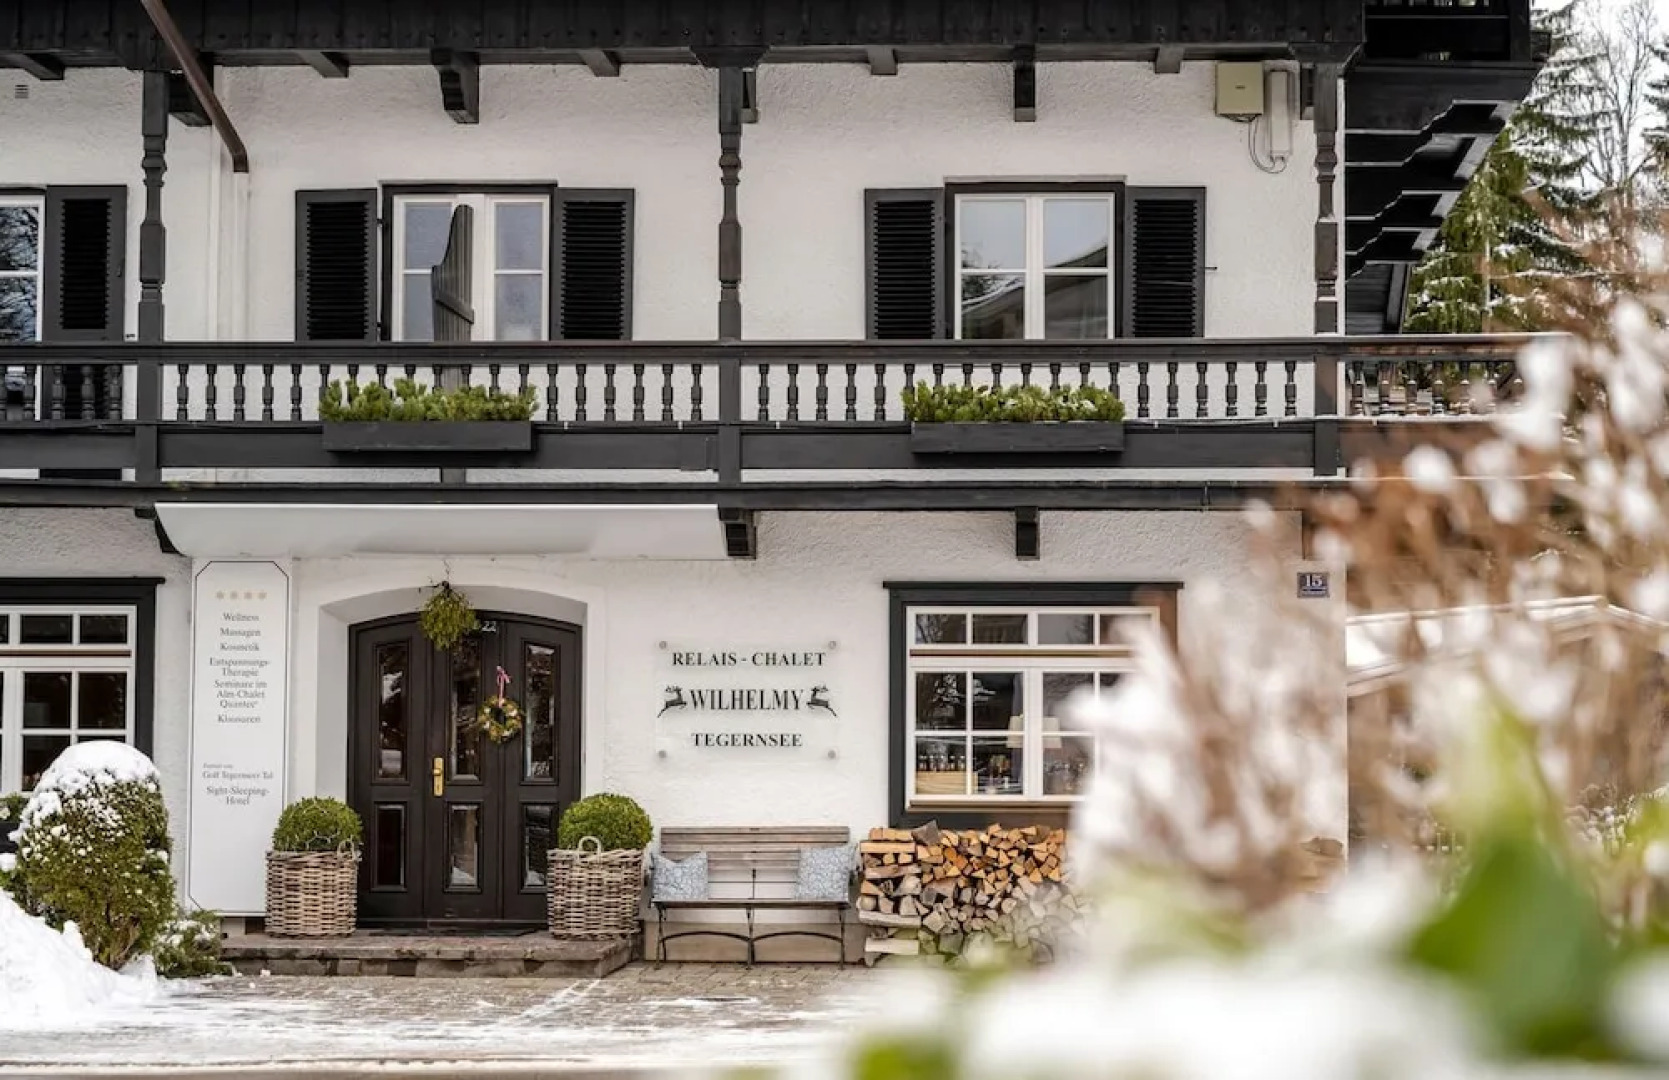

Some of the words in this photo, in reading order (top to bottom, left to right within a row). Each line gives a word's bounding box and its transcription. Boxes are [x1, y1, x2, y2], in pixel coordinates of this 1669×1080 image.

[1306, 575, 1323, 587] 15
[222, 612, 260, 622] Wellness
[220, 626, 261, 638] Massagen
[220, 642, 260, 651] Kosmetik
[672, 651, 738, 667] RELAIS
[751, 651, 827, 667] CHALET
[221, 666, 259, 677] Therapie
[689, 688, 805, 711] WILHELMY
[690, 732, 803, 748] TEGERNSEE
[226, 795, 250, 805] Hotel
